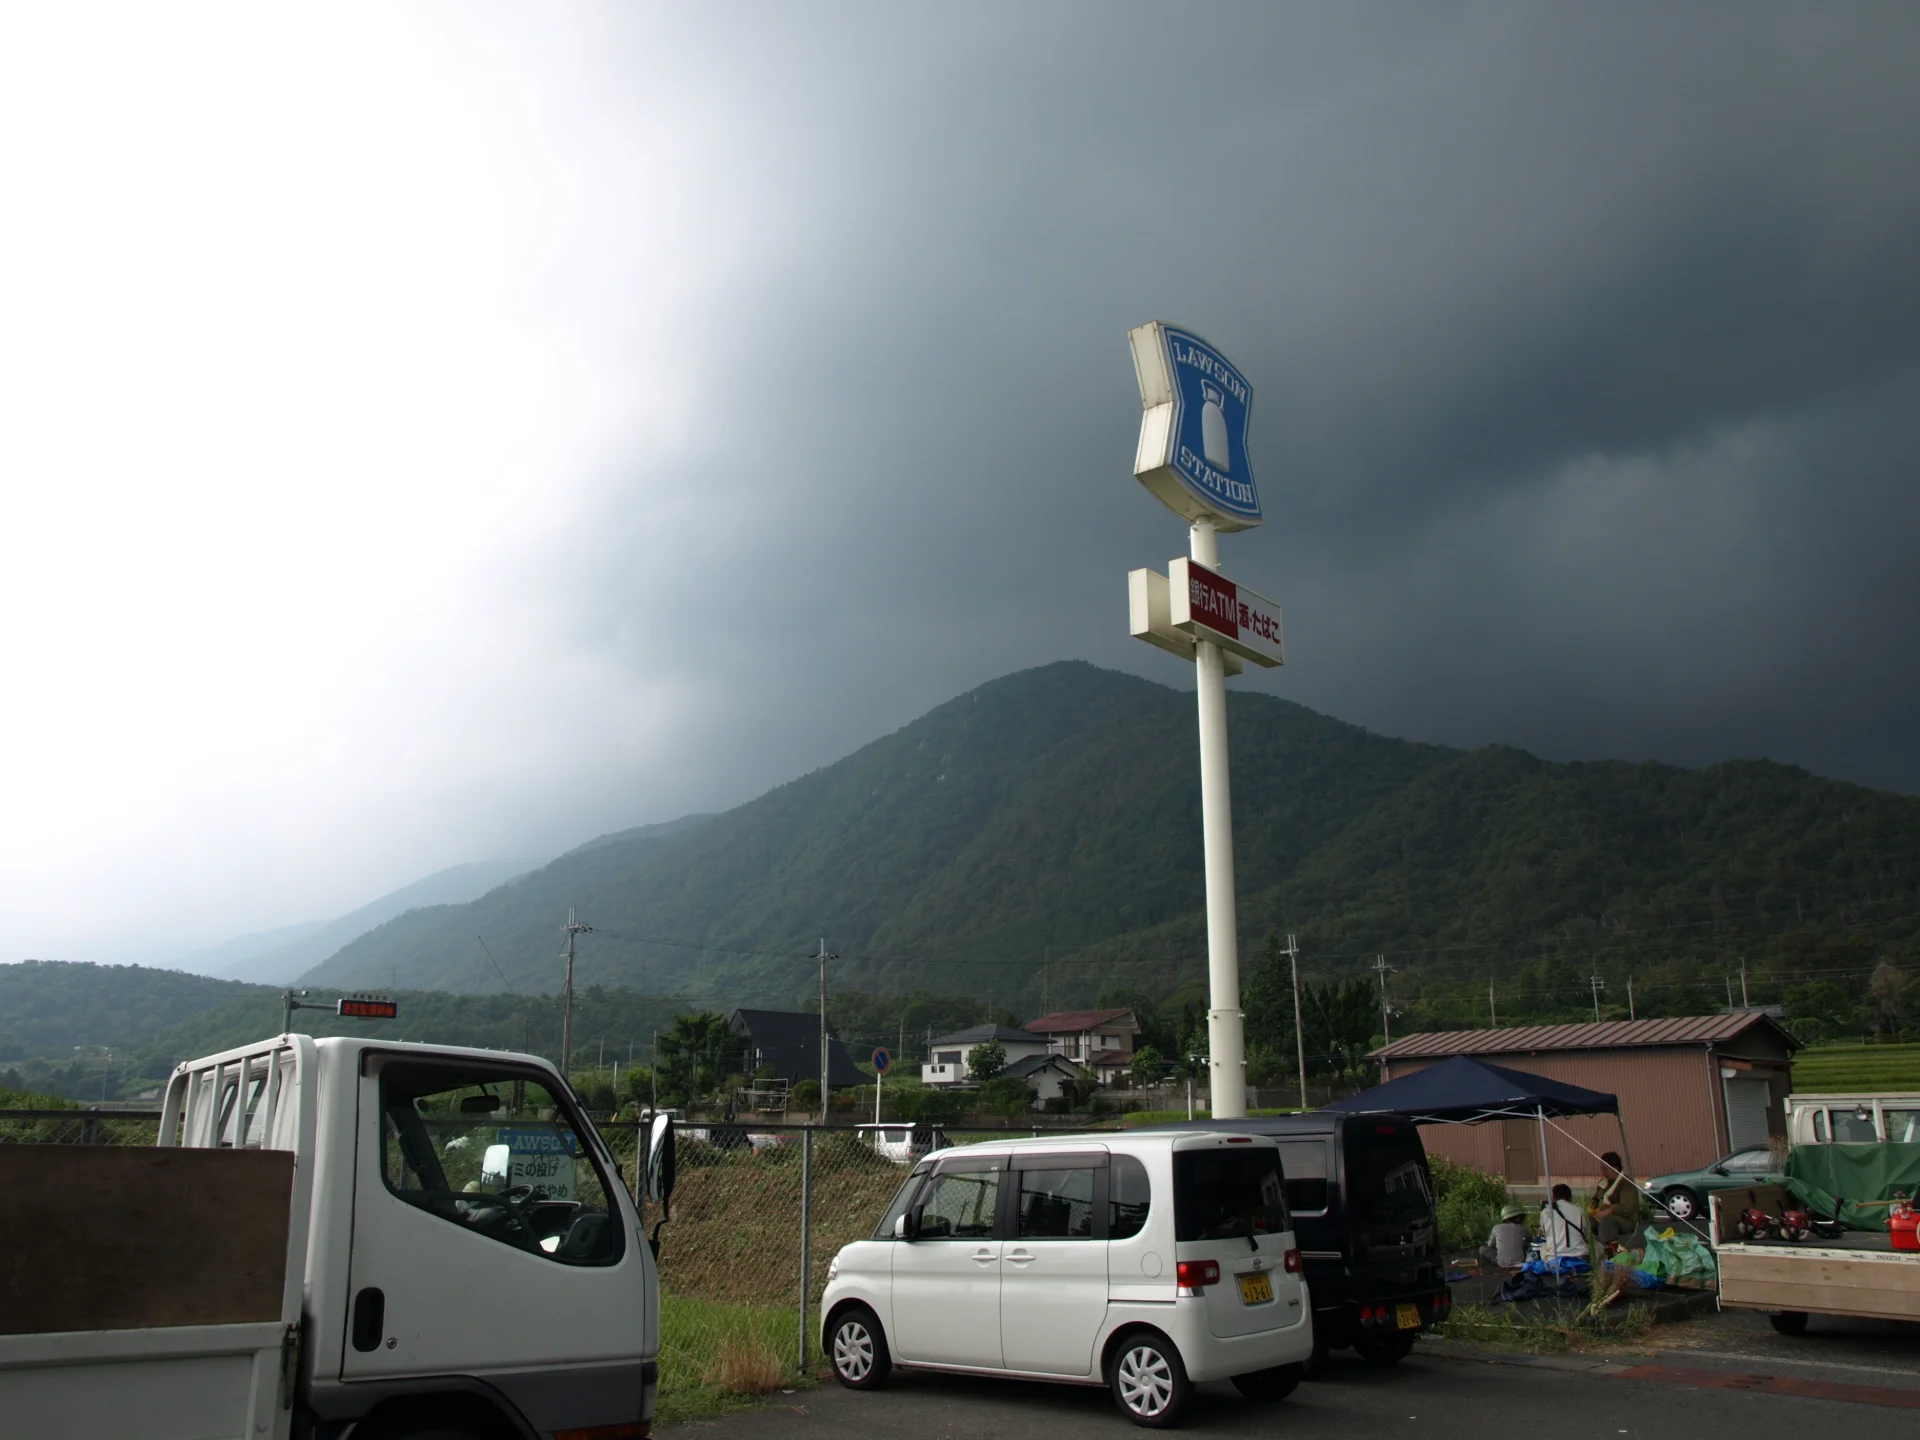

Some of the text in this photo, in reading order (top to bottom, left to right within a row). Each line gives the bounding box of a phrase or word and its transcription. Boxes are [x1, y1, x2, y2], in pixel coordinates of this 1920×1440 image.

[1174, 342, 1247, 404] LAWSON
[1180, 445, 1254, 504] STATION
[1191, 578, 1236, 623] 銀行ATM
